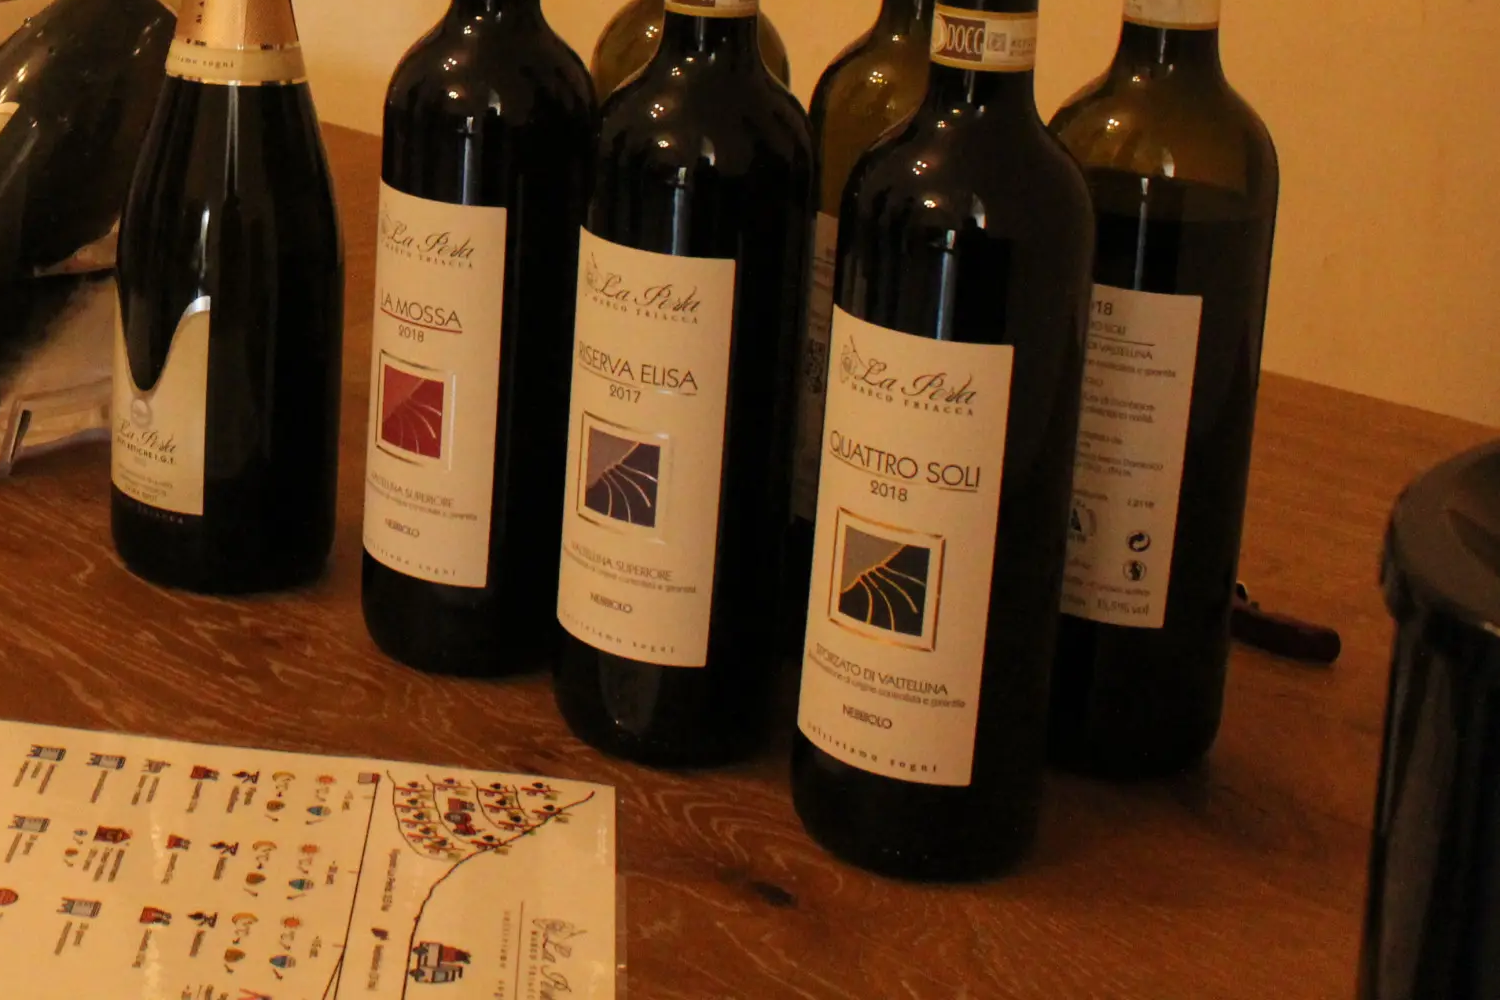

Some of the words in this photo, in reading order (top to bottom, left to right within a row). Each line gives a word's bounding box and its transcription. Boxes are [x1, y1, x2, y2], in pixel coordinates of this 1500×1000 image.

[946, 23, 984, 55] DOCG
[202, 58, 236, 70] sogni
[387, 220, 414, 247] La
[416, 231, 475, 260] Perla
[596, 272, 631, 300] La
[634, 283, 701, 313] Perla
[395, 297, 463, 329] MOSSA
[591, 296, 628, 313] MARCO
[635, 308, 698, 325] TRIACCA
[398, 324, 425, 344] 2018
[1099, 341, 1154, 361] VALTELLINA
[578, 340, 635, 381] RISERVA
[640, 364, 698, 391] ELISA
[609, 383, 642, 404] 2017
[854, 358, 897, 391] La
[901, 371, 978, 406] Perla
[851, 380, 894, 403] MARCO
[903, 398, 975, 417] TRIACCA
[136, 430, 177, 454] Perla
[829, 430, 919, 480] QUATTRO
[926, 461, 981, 489] SOLI
[870, 479, 909, 503] 2018
[615, 560, 674, 582] SUPERIORE
[632, 640, 676, 655] sogni
[863, 667, 876, 683] DI
[877, 671, 948, 695] VALTELLINA
[842, 703, 893, 730] NEBBIOLO
[889, 757, 937, 774] sogni
